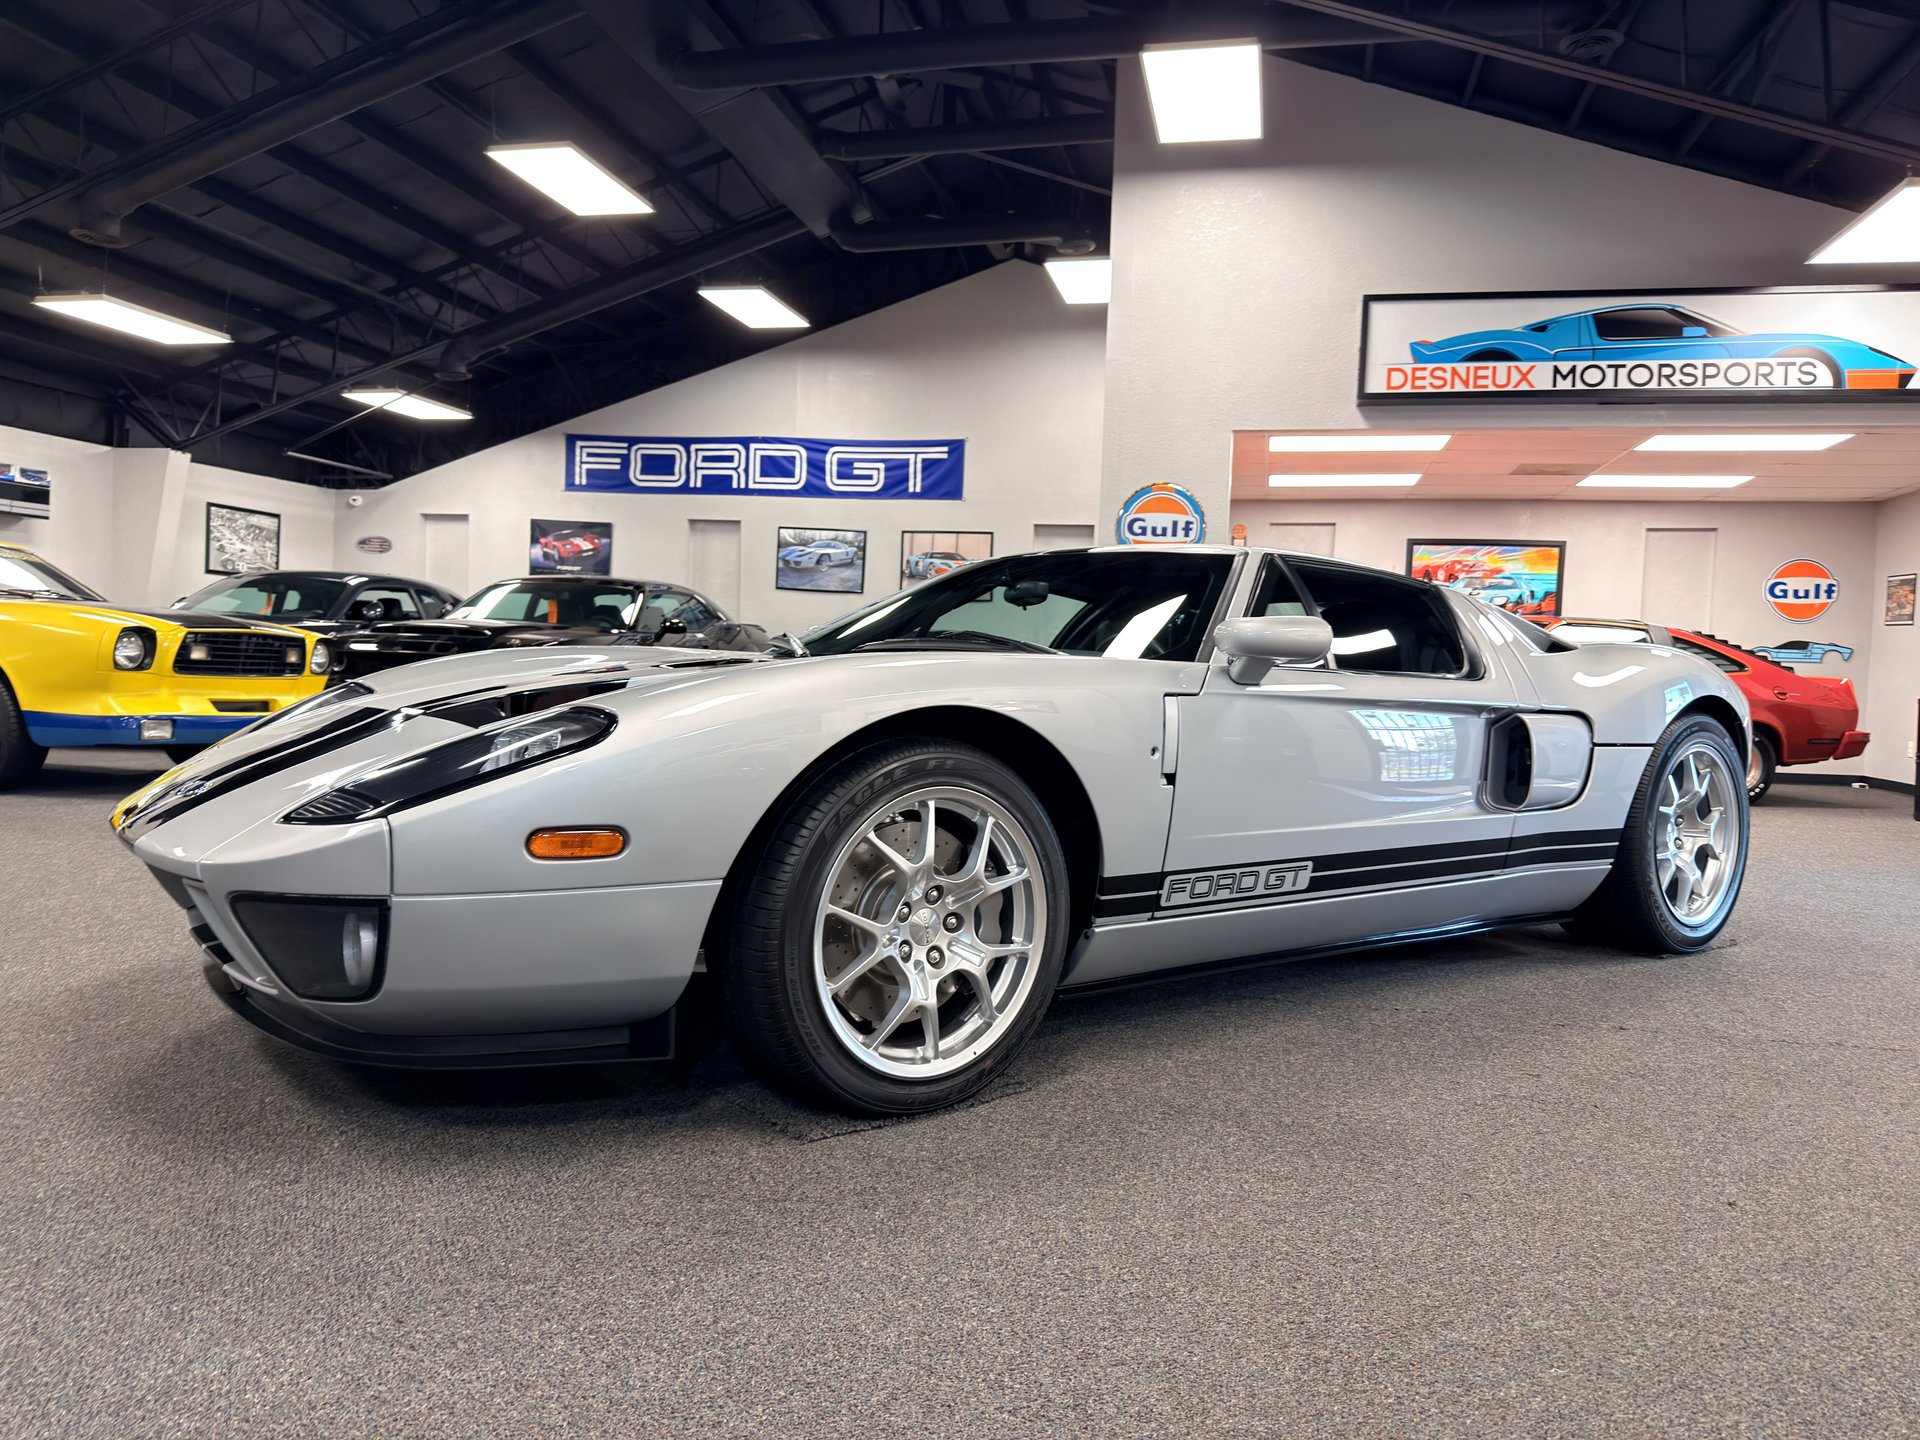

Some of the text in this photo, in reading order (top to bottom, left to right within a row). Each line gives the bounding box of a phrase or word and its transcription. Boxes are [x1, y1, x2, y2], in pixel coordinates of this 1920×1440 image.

[1385, 360, 1818, 391] DESNEUX MOTORSPORTS
[574, 439, 949, 493] FORD GT
[1126, 517, 1195, 538] Gulf
[1768, 581, 1836, 600] Gulf
[1165, 864, 1309, 903] FORD GT
